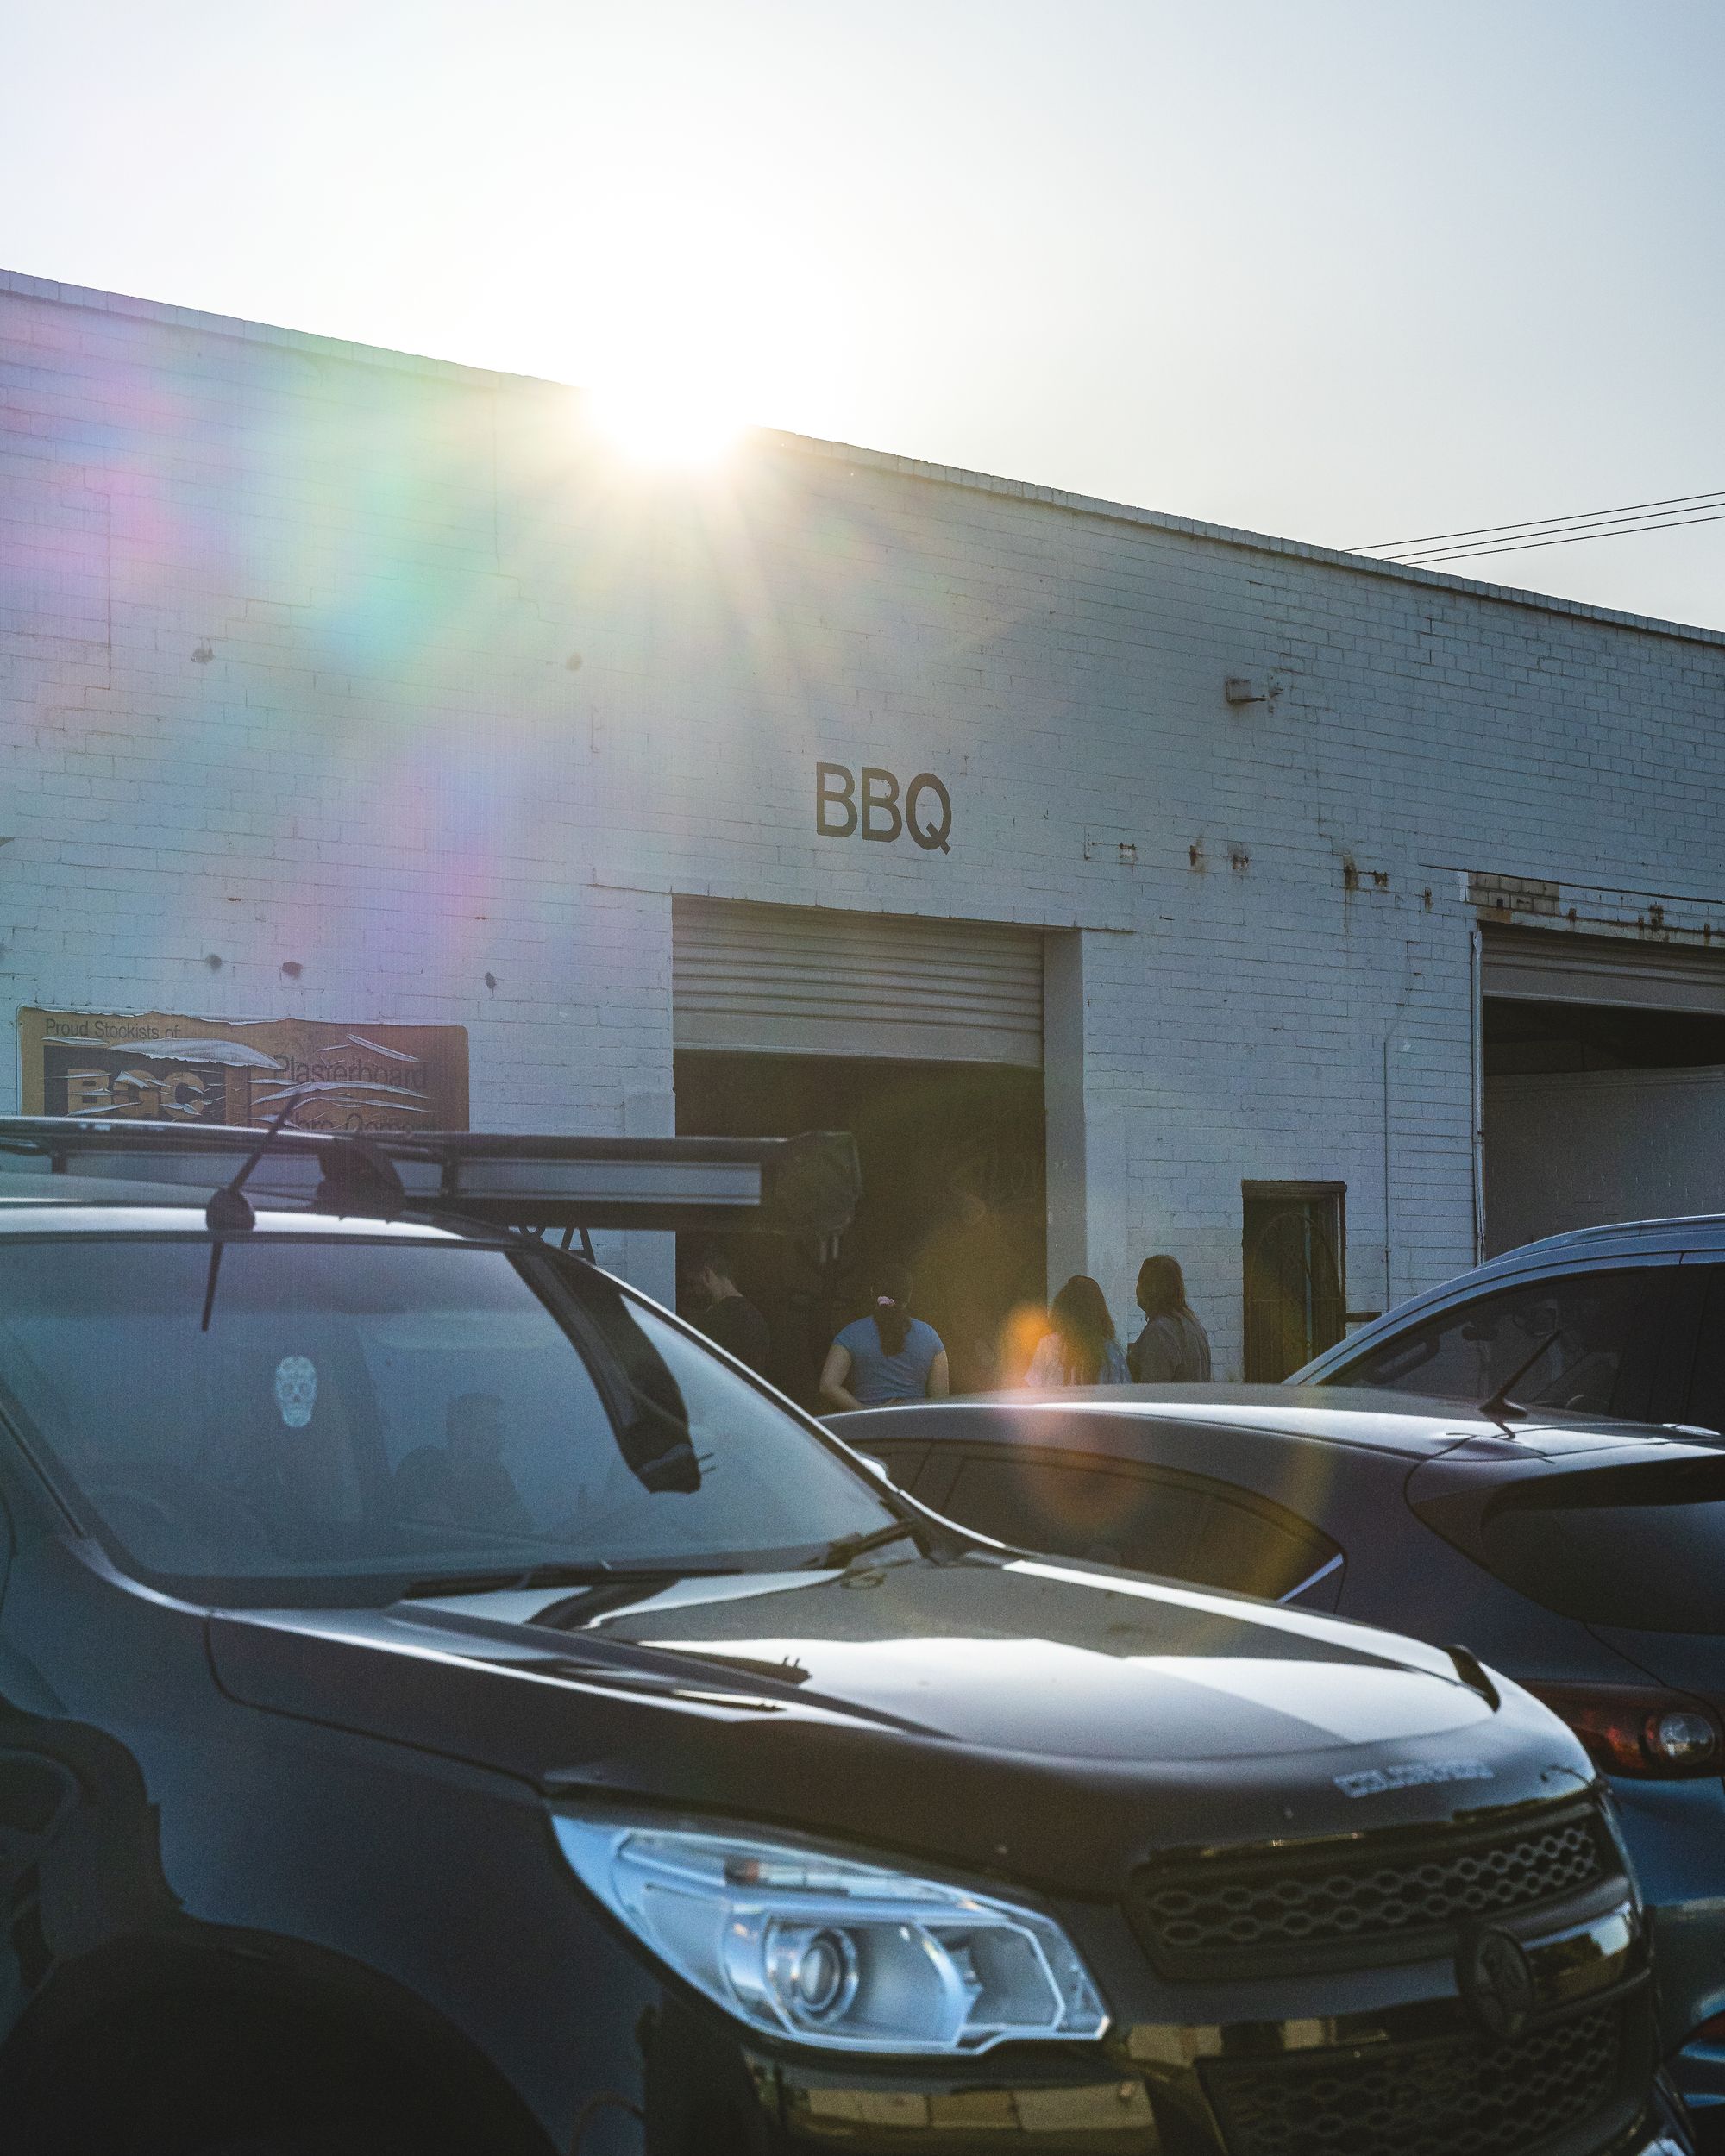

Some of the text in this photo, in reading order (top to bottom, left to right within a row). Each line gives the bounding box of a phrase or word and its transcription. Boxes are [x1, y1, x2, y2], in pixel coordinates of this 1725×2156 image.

[817, 762, 951, 855] BBQ
[46, 1018, 88, 1037] Proud
[95, 1020, 159, 1039] Stockists
[273, 1053, 429, 1089] Plasterboard
